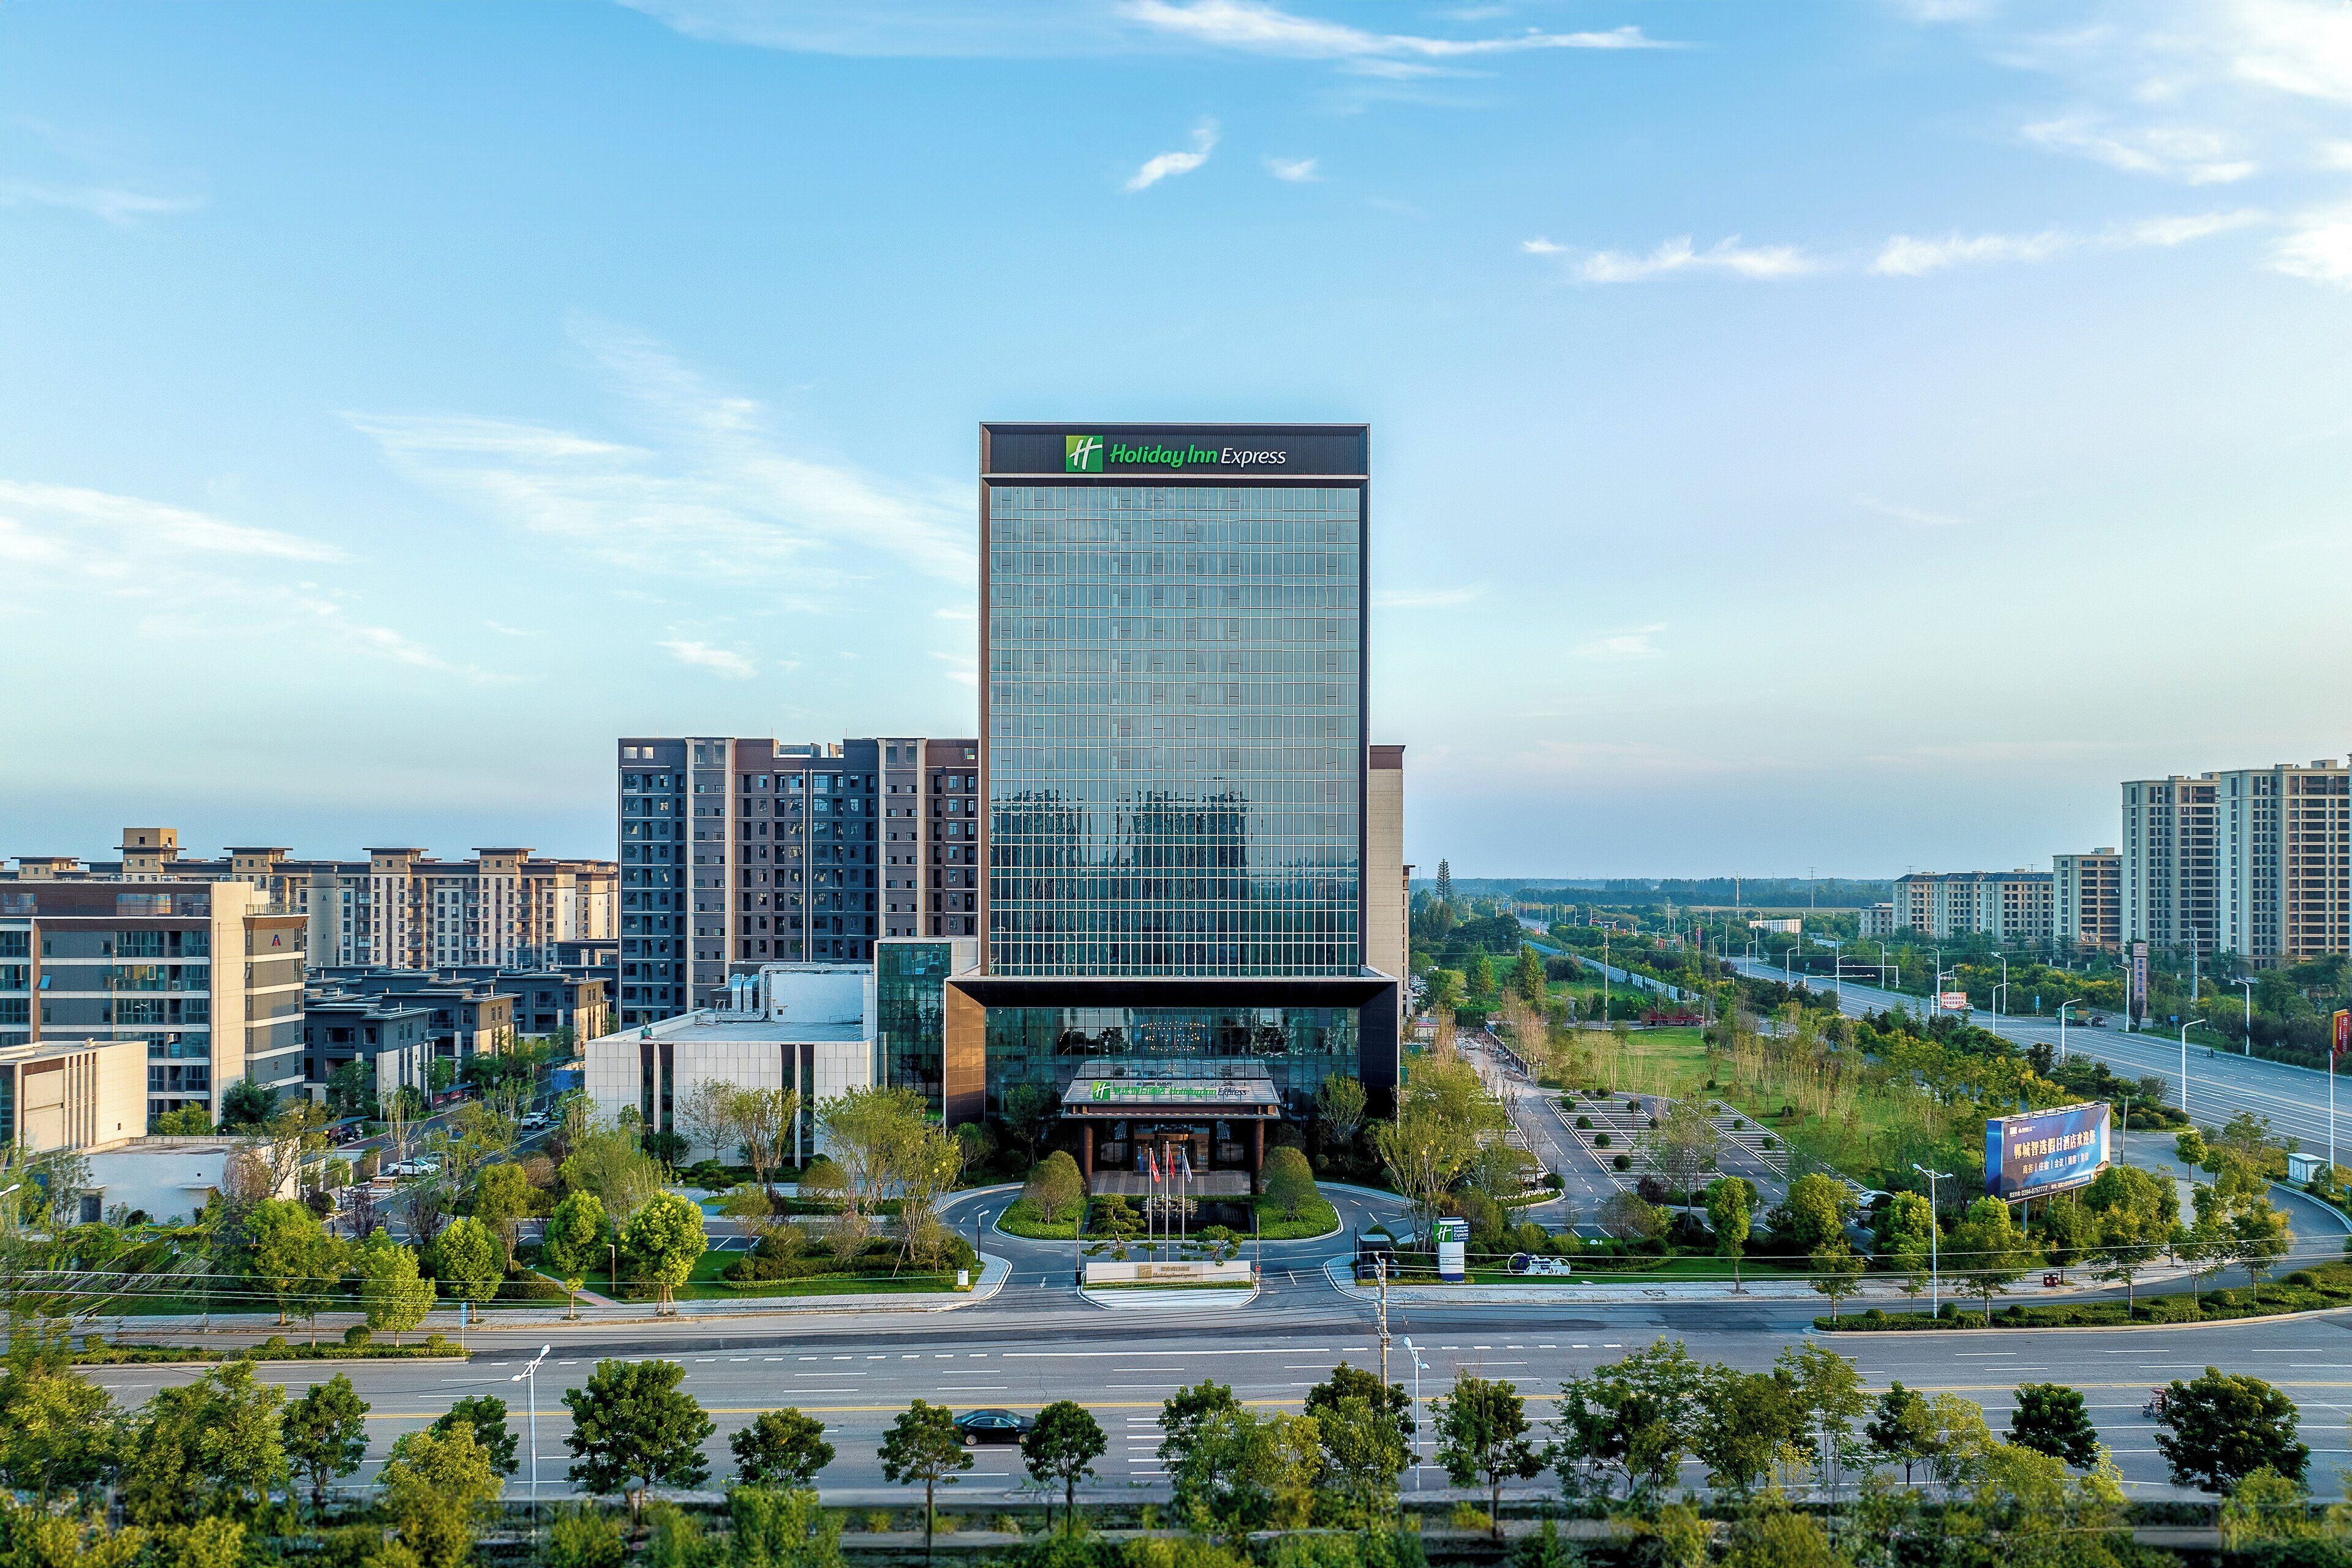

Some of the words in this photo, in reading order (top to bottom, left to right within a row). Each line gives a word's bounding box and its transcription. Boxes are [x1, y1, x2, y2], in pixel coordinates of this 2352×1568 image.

[1110, 443, 1185, 468] Holiday
[1187, 445, 1218, 463] Inn
[1221, 448, 1286, 468] Express
[1218, 1088, 1246, 1097] Express
